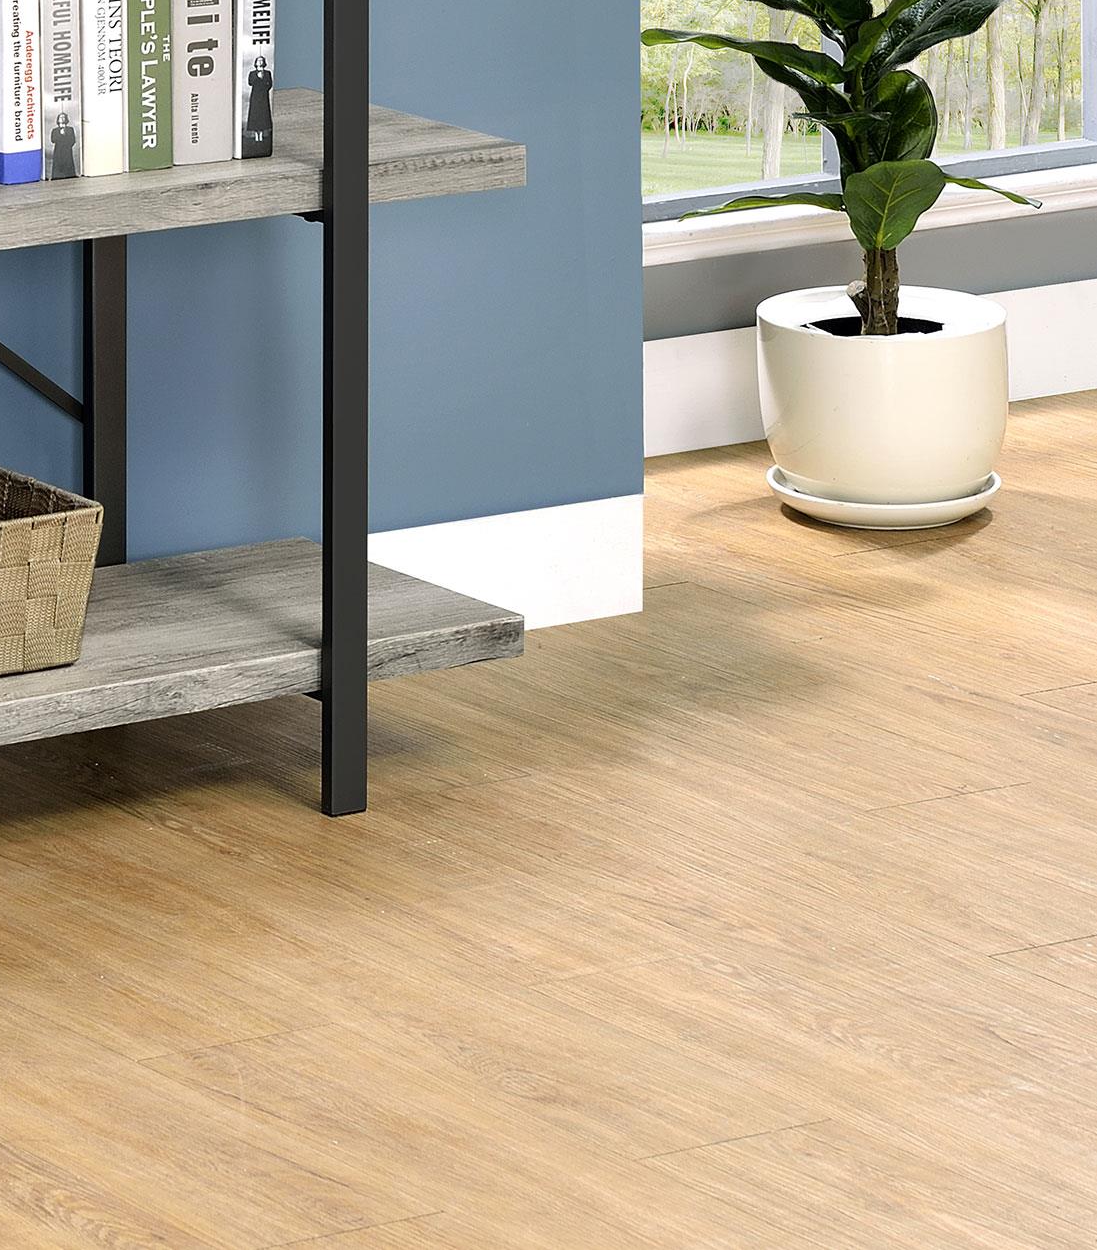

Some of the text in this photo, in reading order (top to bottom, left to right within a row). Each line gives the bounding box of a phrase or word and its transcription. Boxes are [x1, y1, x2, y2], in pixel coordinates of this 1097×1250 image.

[13, 40, 22, 58] the
[94, 7, 106, 61] GJENNOM
[162, 34, 171, 62] THE
[53, 30, 72, 103] HOMELIFE
[108, 33, 122, 93] TEORI
[186, 38, 219, 77] te
[13, 61, 22, 107] furniture
[24, 30, 36, 140] Anderegg Architects
[141, 59, 158, 149] LAWYER
[190, 92, 199, 114] Abita
[14, 110, 23, 142] brand
[191, 122, 199, 144] vento
